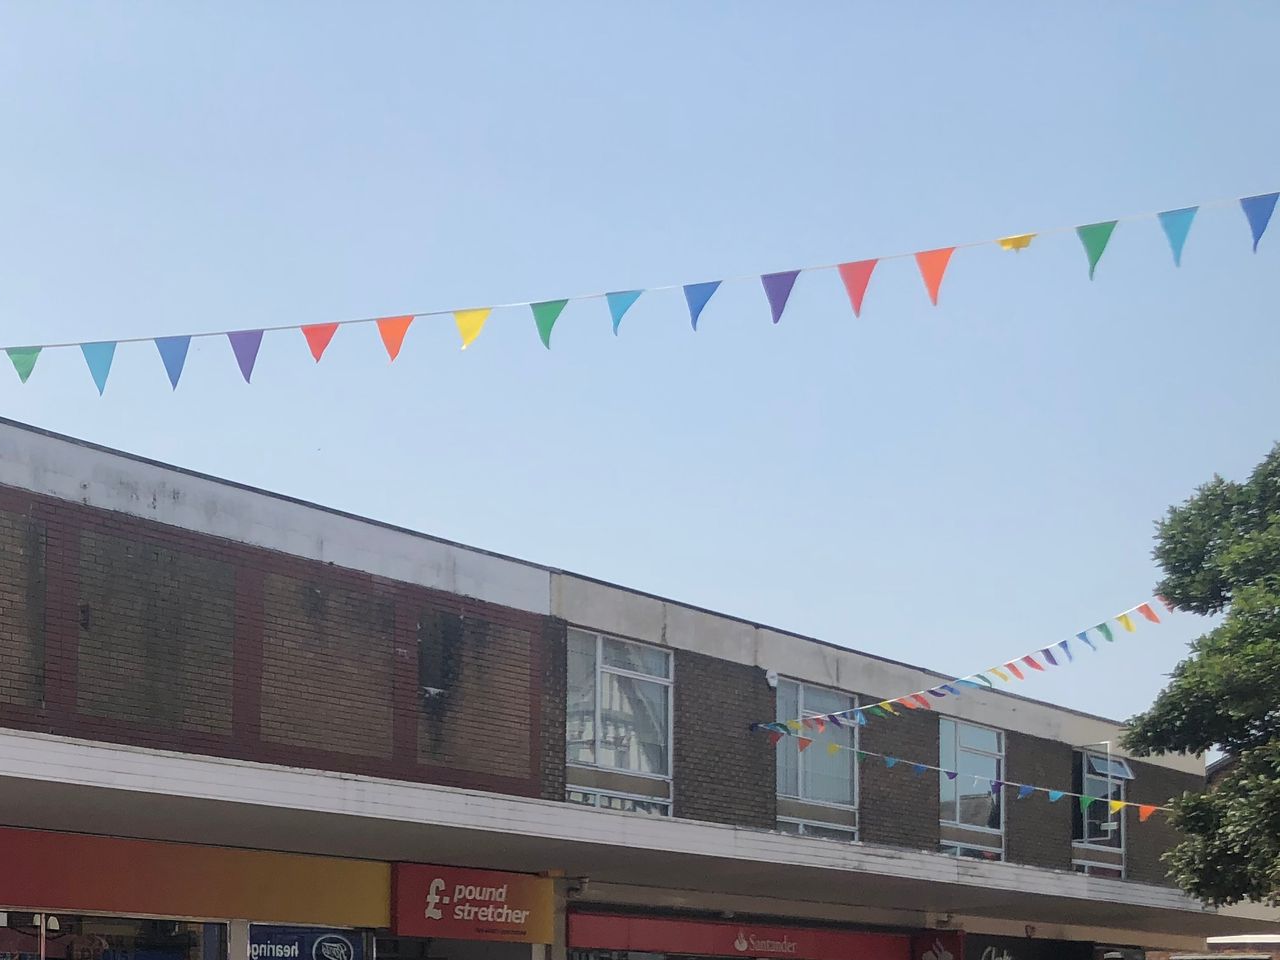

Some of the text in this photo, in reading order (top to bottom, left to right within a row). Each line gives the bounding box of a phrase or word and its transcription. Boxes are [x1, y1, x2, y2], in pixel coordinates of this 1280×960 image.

[453, 884, 508, 902] pound
[453, 903, 529, 923] stretcher
[749, 934, 798, 952] Santander
